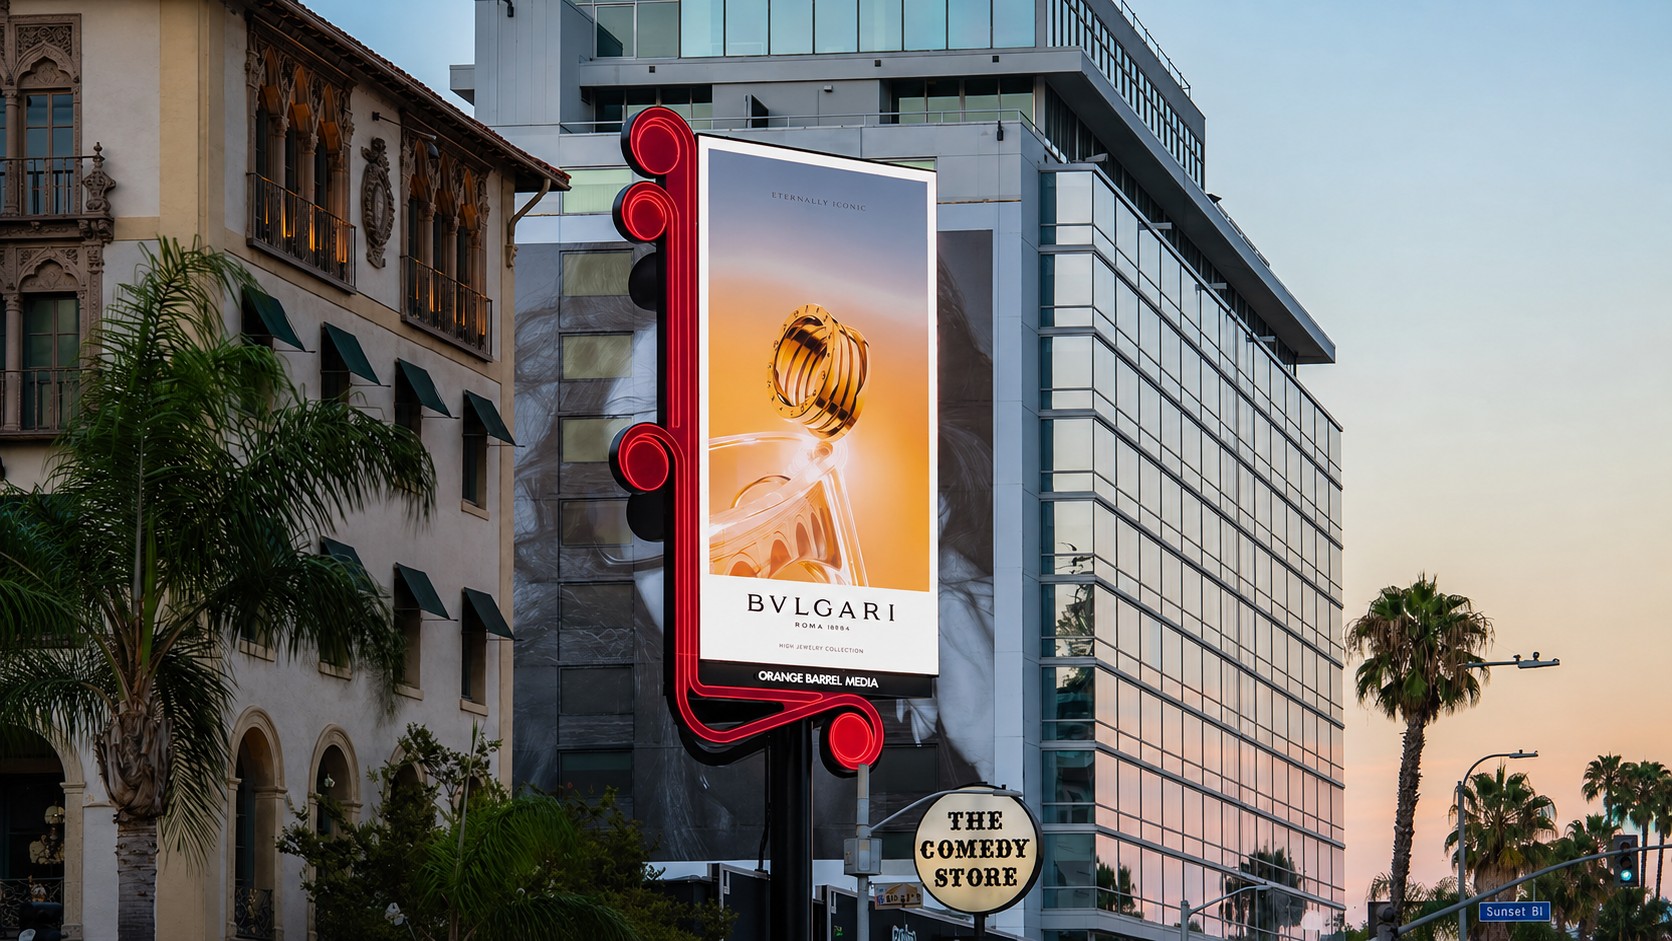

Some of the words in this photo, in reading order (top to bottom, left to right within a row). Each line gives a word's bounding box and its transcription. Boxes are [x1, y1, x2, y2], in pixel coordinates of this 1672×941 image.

[771, 191, 828, 206] ETERNALLY
[832, 201, 866, 211] ICONIC
[747, 593, 895, 622] BVLGARI
[795, 622, 823, 630] ROMA
[825, 646, 864, 654] COLLECTION
[758, 670, 803, 683] ORANGE
[805, 673, 842, 686] BARREL
[845, 676, 879, 688] MEDIA
[948, 811, 1003, 830] THE
[920, 839, 1030, 859] COMEDY
[934, 867, 1017, 887] STORE
[1486, 906, 1526, 917] Sunset
[1532, 906, 1543, 917] Bl
